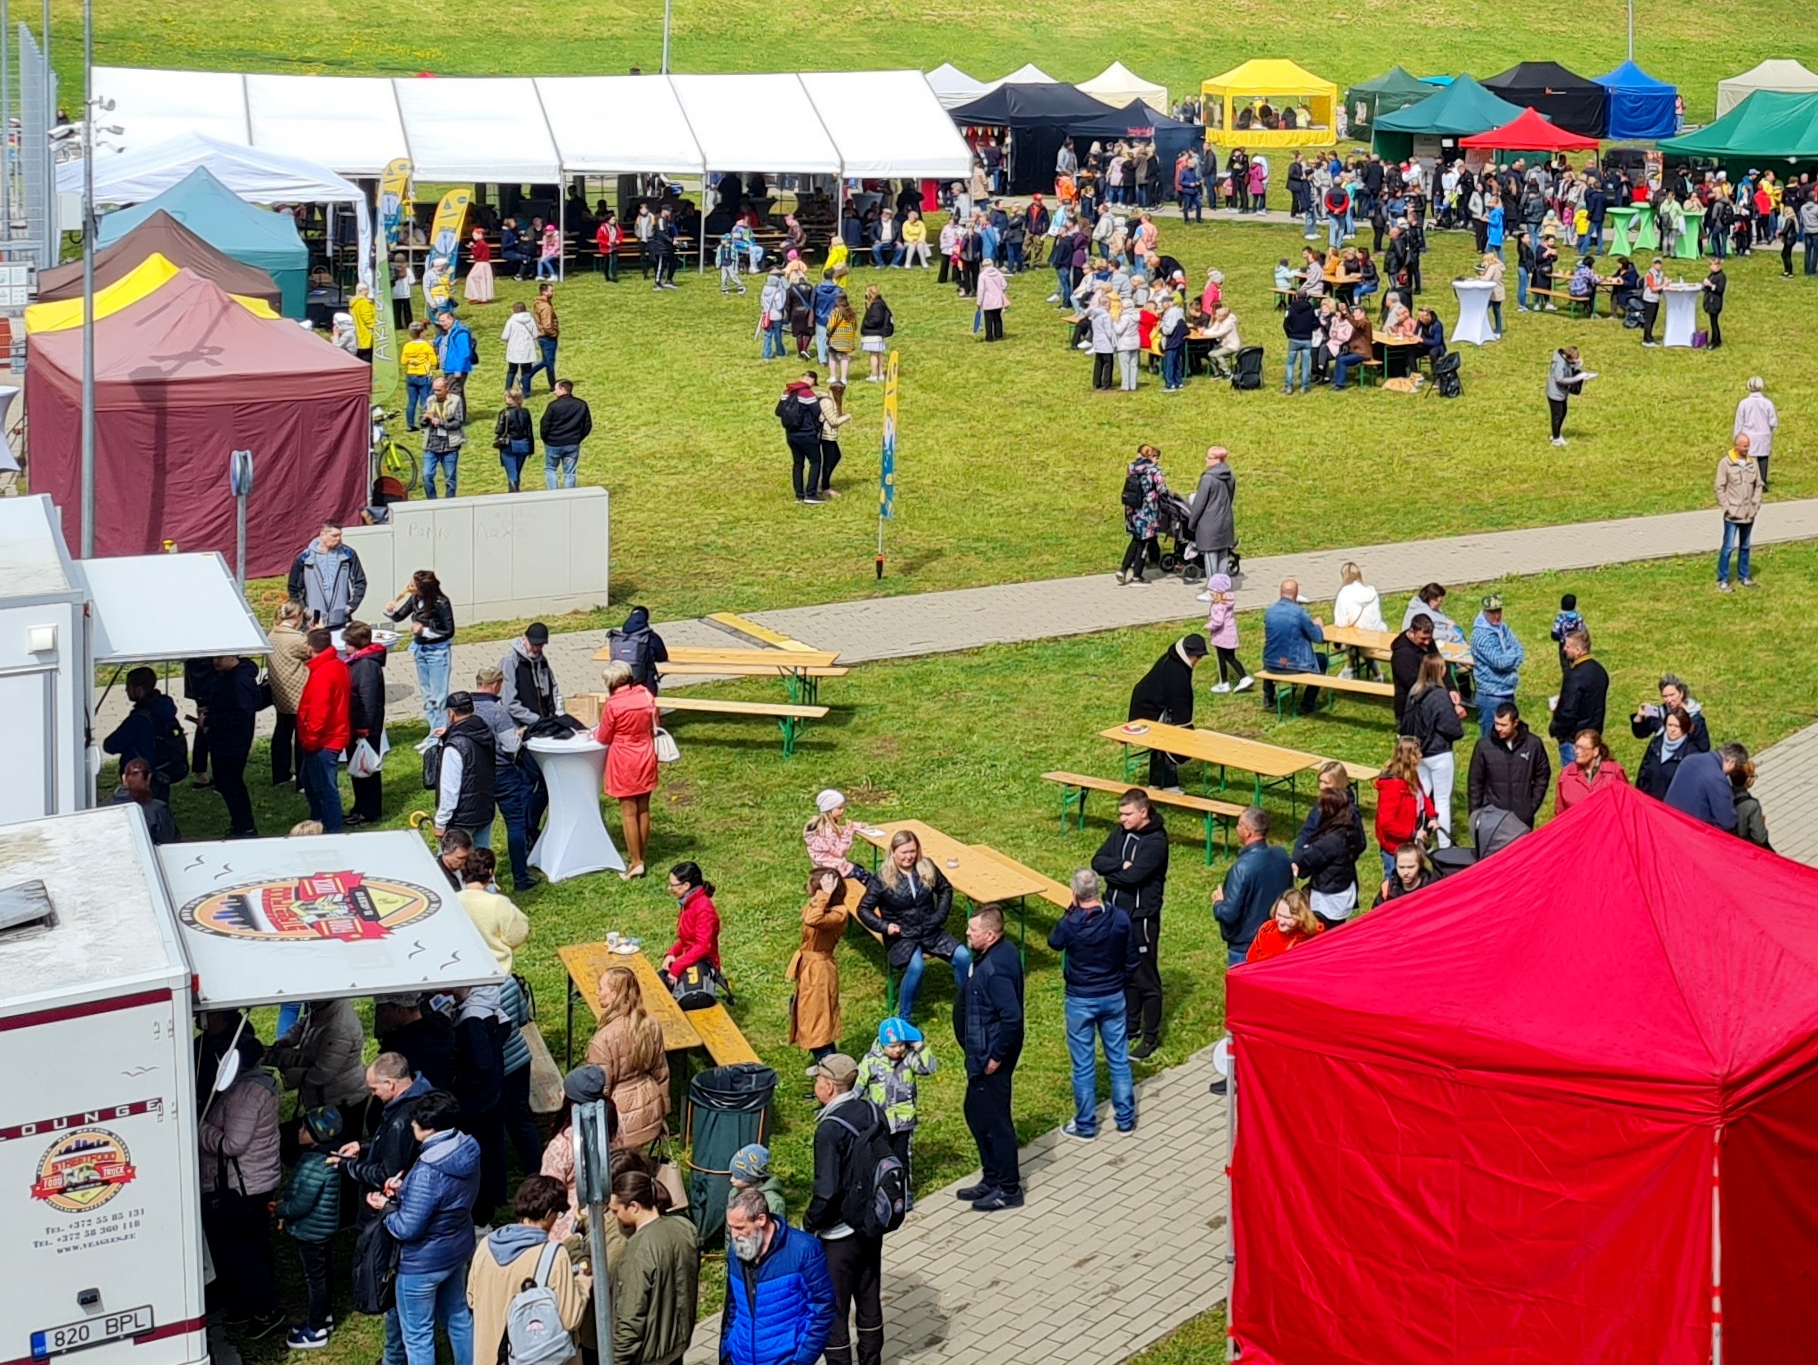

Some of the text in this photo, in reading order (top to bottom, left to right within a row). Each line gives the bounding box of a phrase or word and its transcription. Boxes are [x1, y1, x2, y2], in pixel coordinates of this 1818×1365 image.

[103, 1165, 125, 1177] TRUCK
[68, 1219, 92, 1229] +372
[56, 1232, 80, 1242] +372
[54, 1312, 146, 1347] 820 BPL
